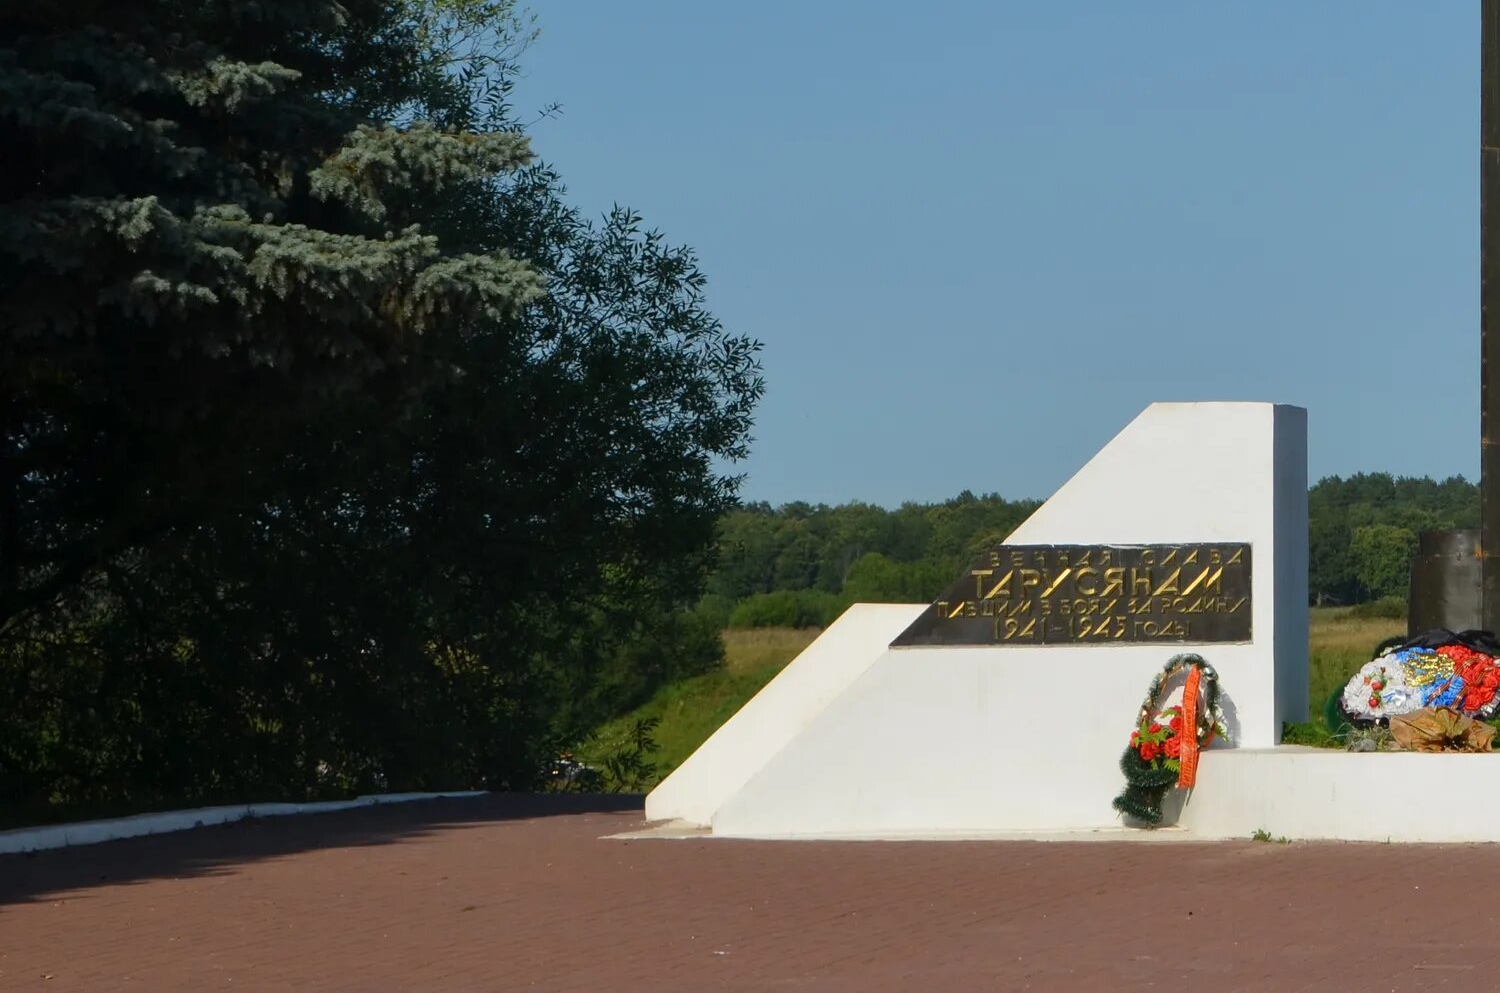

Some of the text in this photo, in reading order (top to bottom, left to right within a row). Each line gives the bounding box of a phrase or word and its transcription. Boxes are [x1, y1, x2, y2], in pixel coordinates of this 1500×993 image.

[990, 548, 1244, 567] ВЕЧНАЯ СЛАВА
[971, 566, 1223, 599] ТАРУСЯНАМ
[936, 597, 1248, 618] ПАВШИМ В БОЯХ ЗА РОДИНУ
[1133, 620, 1191, 638] ГОДЫ
